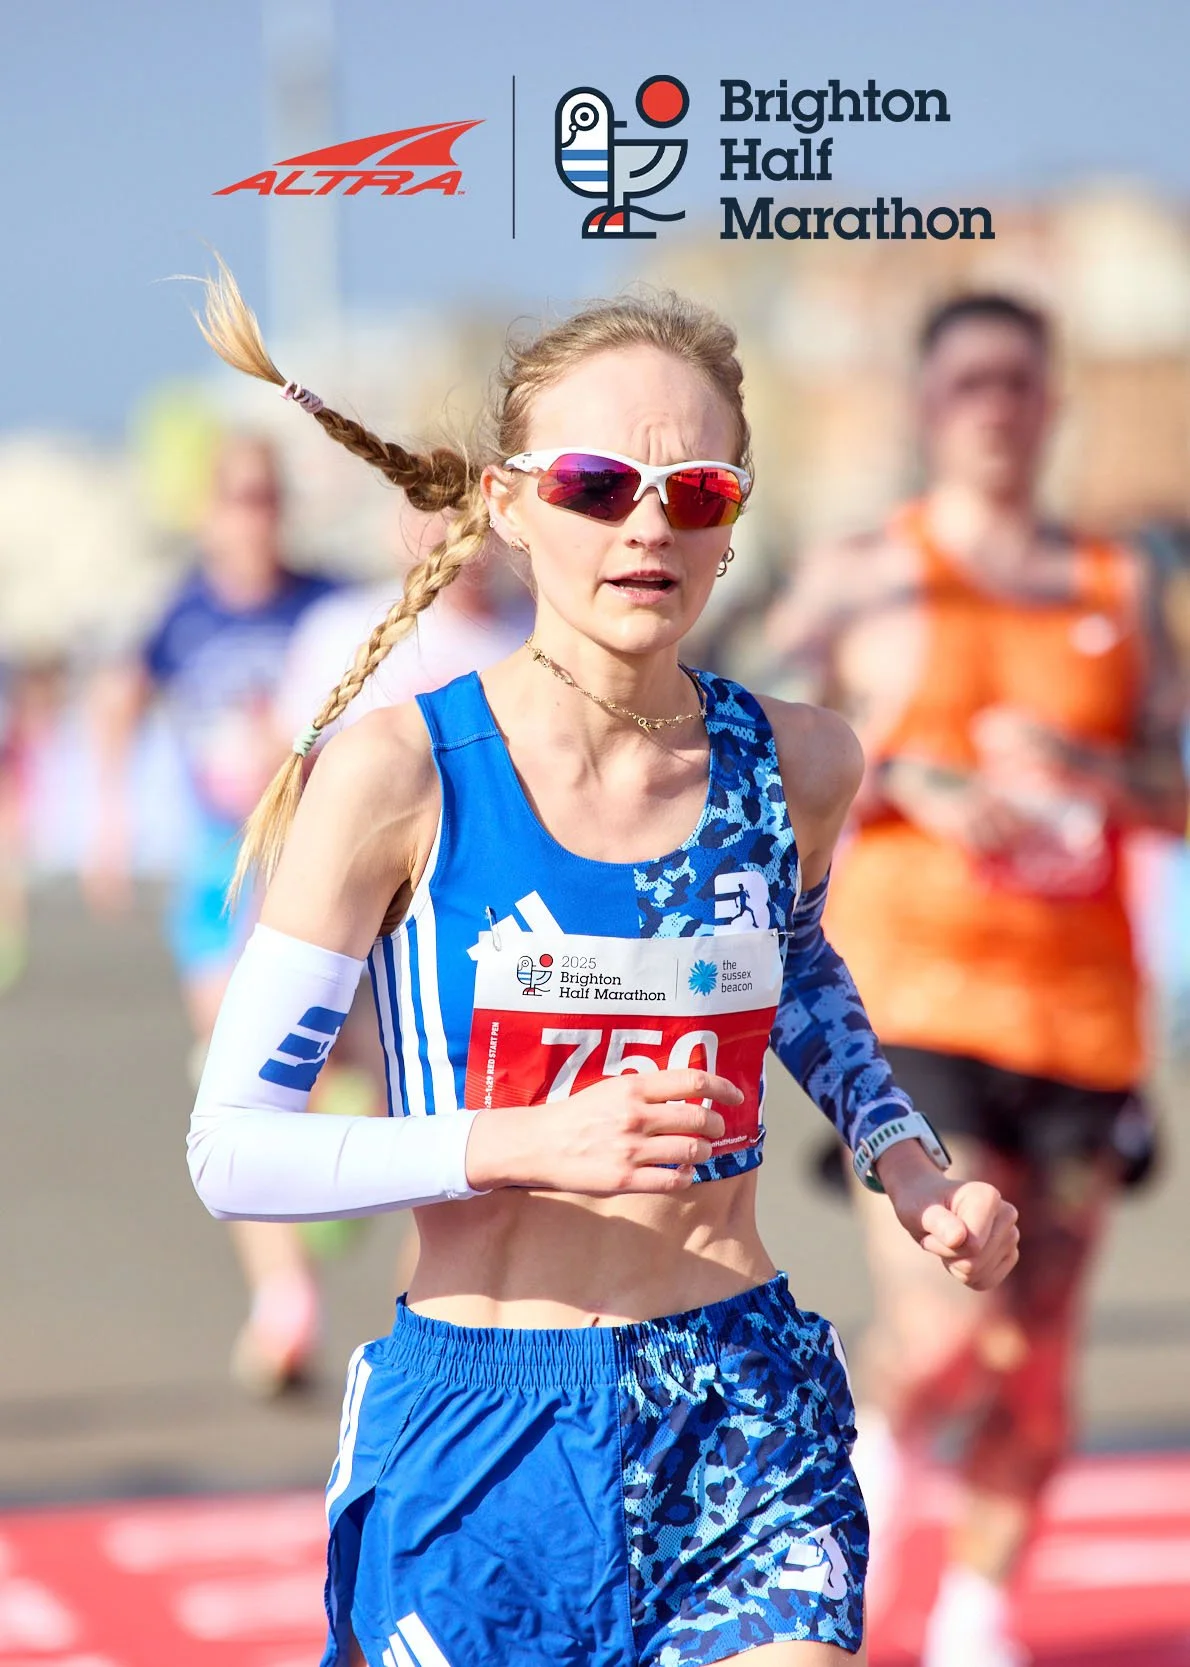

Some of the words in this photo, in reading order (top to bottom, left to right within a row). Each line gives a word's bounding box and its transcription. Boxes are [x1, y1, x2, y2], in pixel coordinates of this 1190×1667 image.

[561, 955, 597, 969] 2025
[722, 959, 737, 971] the
[560, 971, 622, 987] Brighton
[721, 970, 752, 981] sussex
[559, 986, 590, 999] Half
[594, 988, 666, 1001] Marathon
[721, 982, 753, 993] beacon
[491, 1022, 500, 1036] PEN
[488, 1036, 498, 1058] START
[487, 1059, 495, 1074] RED
